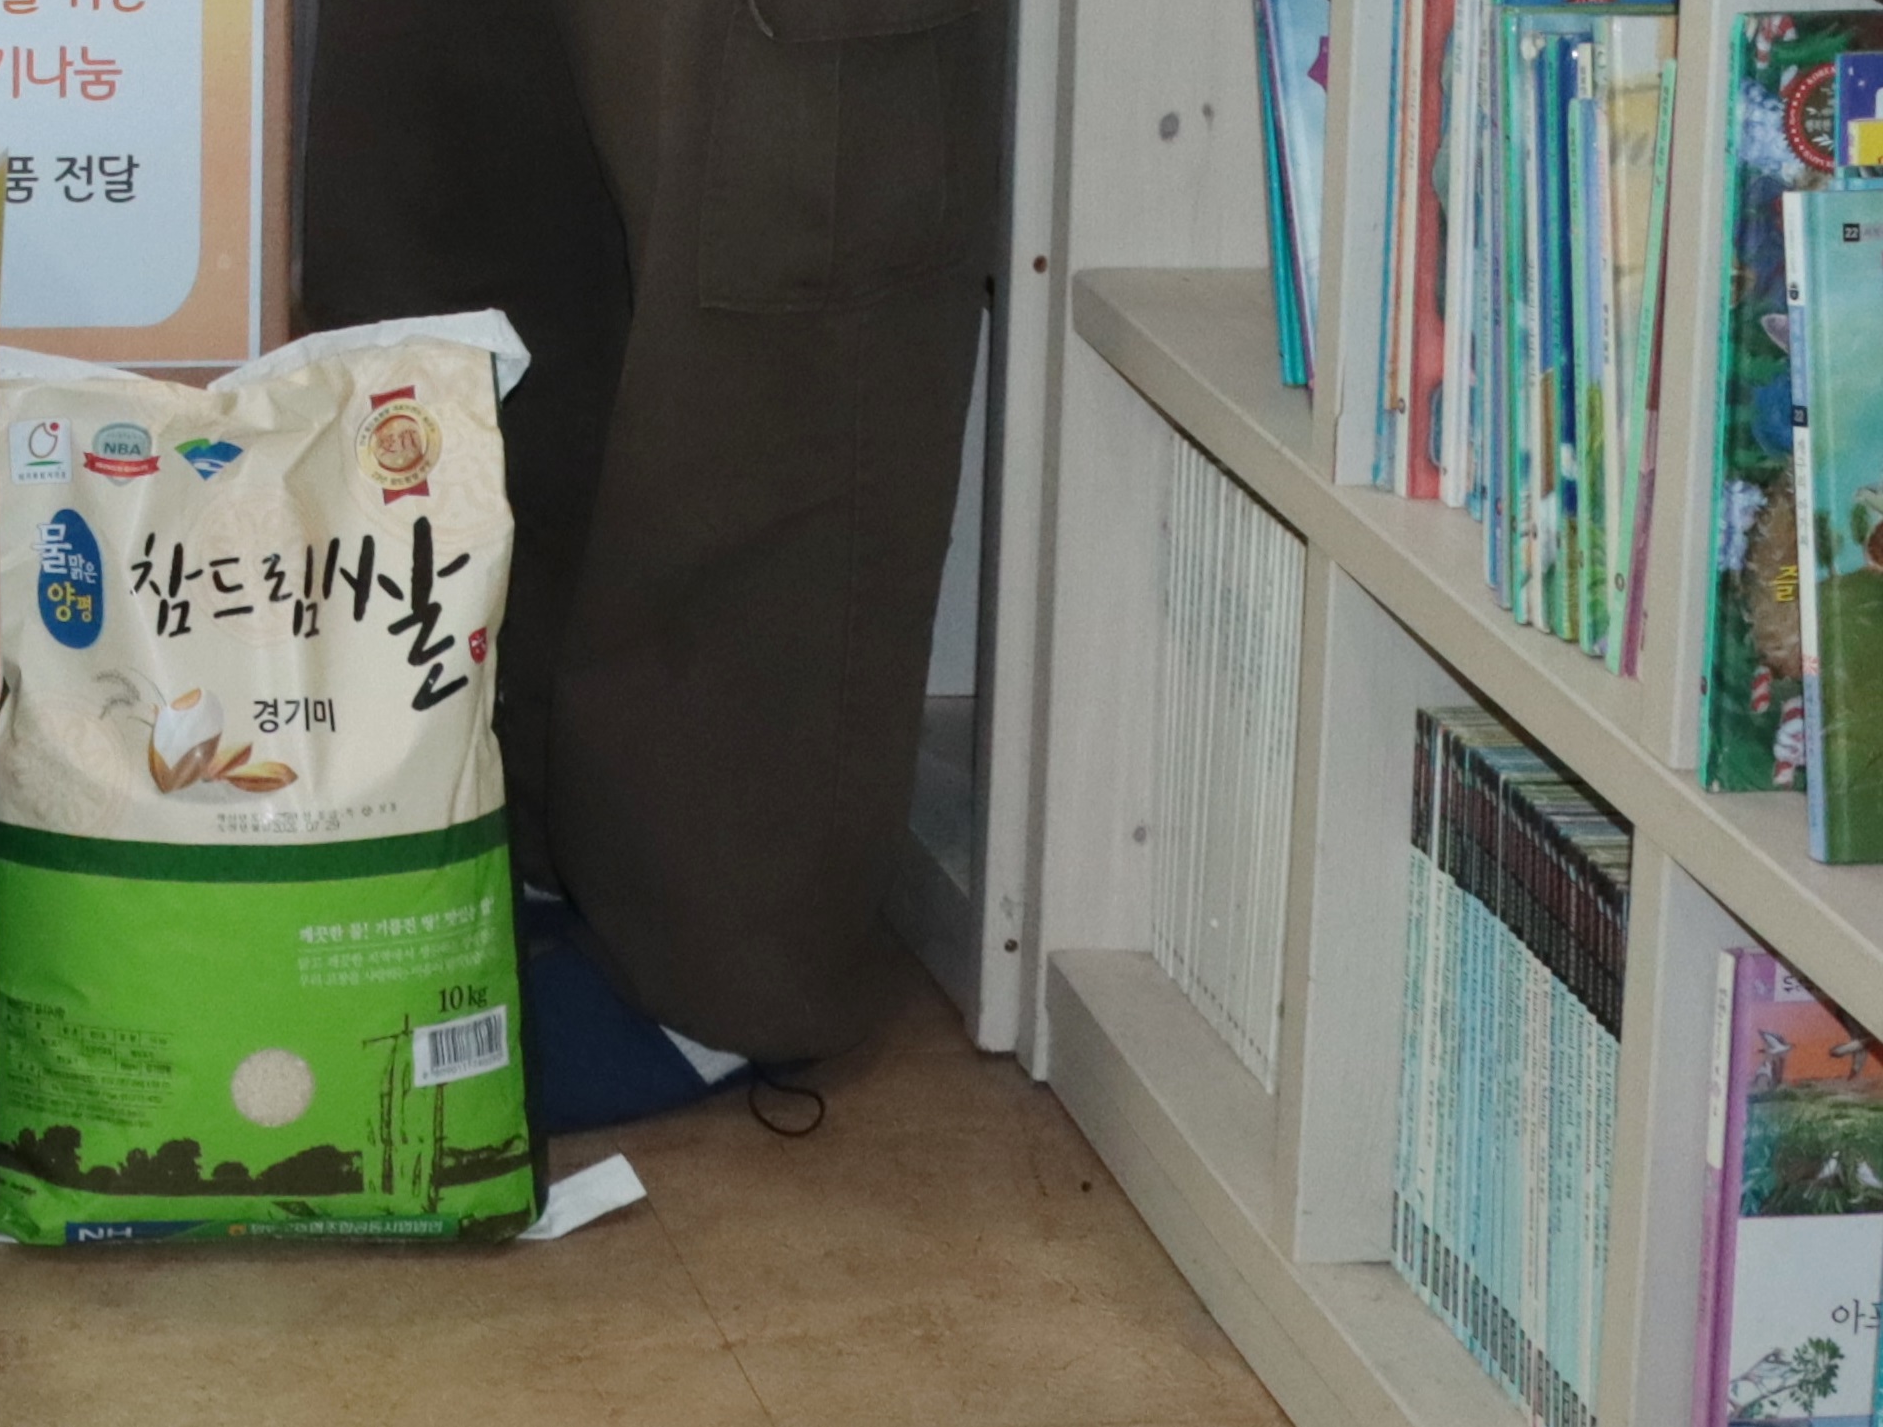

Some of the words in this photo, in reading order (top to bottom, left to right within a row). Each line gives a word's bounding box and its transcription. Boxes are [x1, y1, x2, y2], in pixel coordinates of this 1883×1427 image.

[55, 155, 139, 204] 전달
[103, 441, 141, 456] NBA
[131, 517, 470, 710] 참드림쌀
[253, 699, 337, 733] 경기미
[439, 986, 463, 1012] 10
[468, 985, 487, 1006] kg
